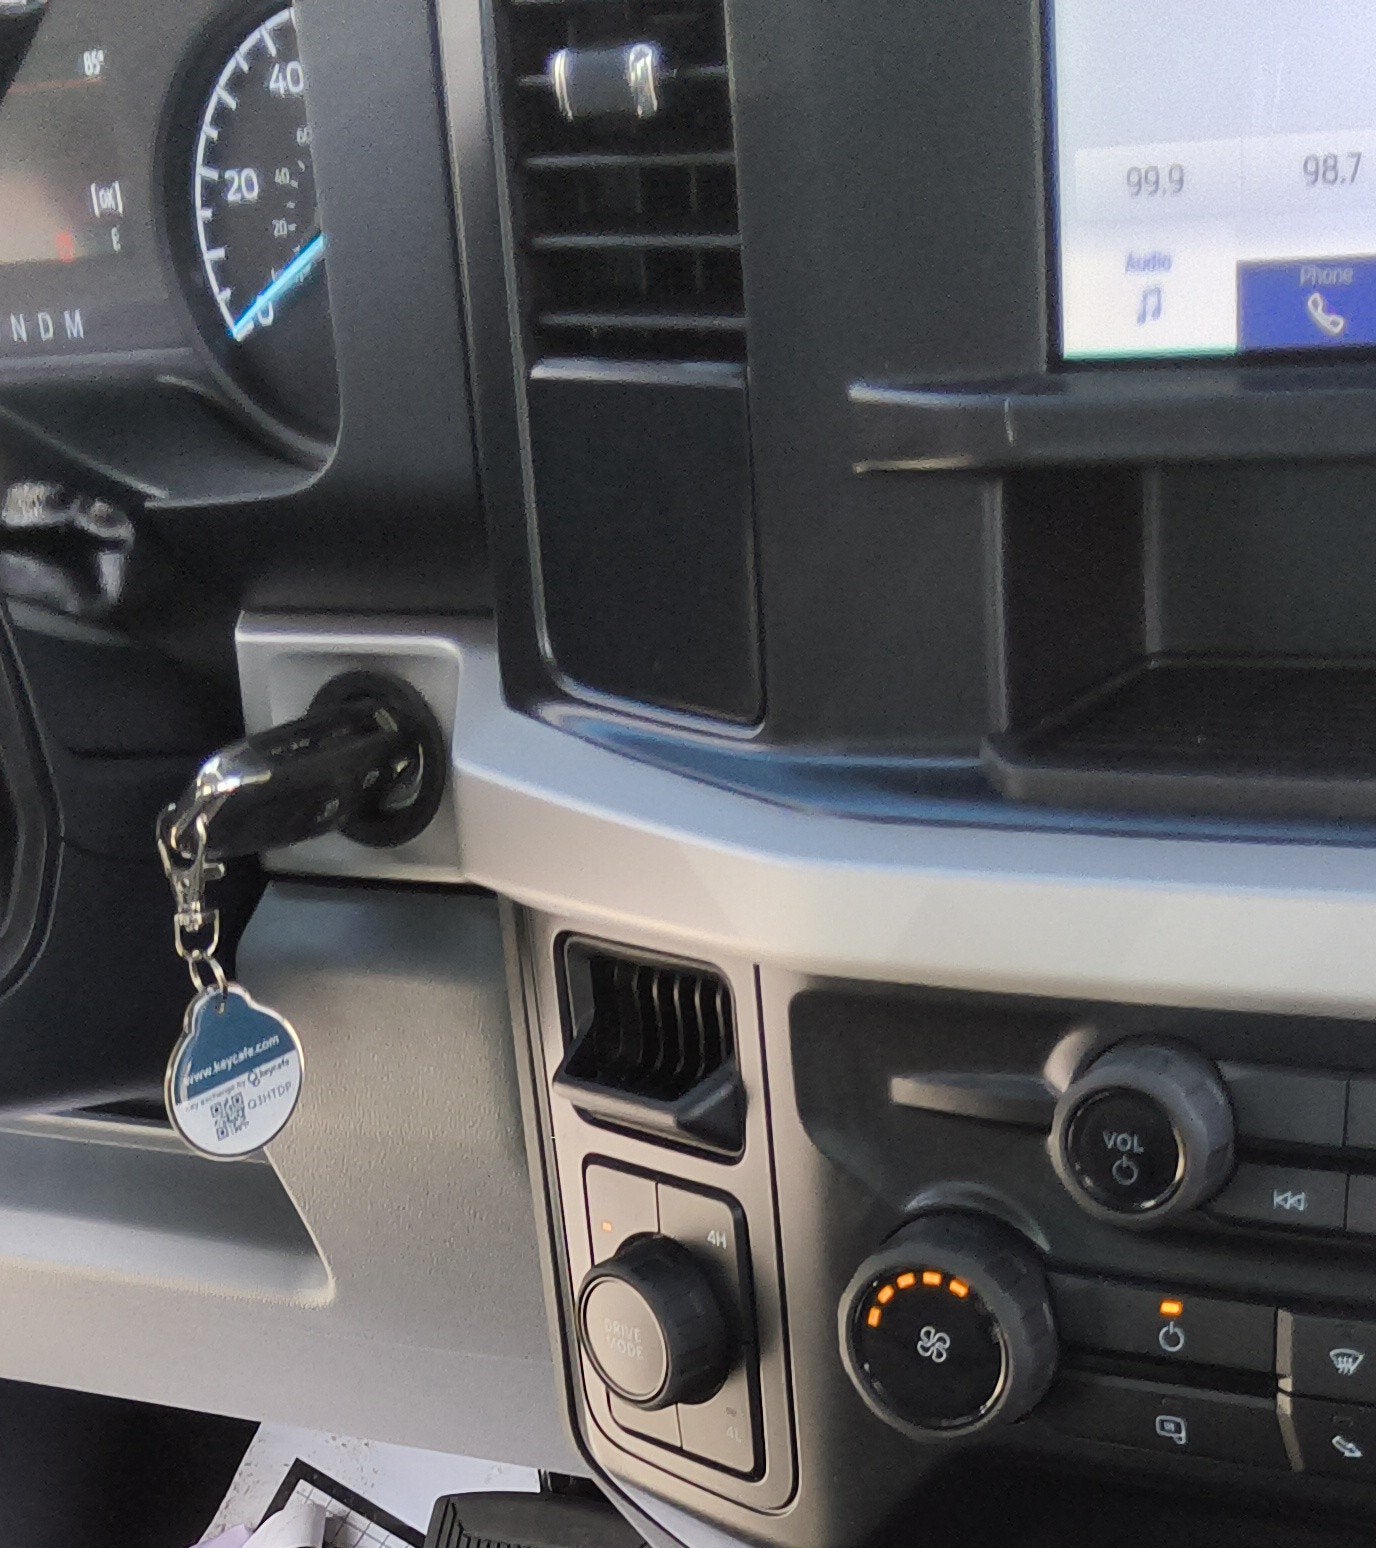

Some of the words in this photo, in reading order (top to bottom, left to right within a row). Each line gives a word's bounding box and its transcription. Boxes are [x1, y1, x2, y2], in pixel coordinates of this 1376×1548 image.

[270, 61, 304, 96] 40
[1126, 163, 1186, 198] 99.9
[1303, 151, 1363, 186] 98.7
[223, 167, 260, 203] 20
[1126, 250, 1173, 272] Audio
[1300, 264, 1354, 285] Phone
[10, 312, 28, 342] N
[37, 310, 54, 341] D
[64, 309, 84, 340] M
[1102, 1130, 1145, 1154] VOL
[707, 1229, 727, 1249] 4H
[603, 1317, 642, 1344] DRIVE
